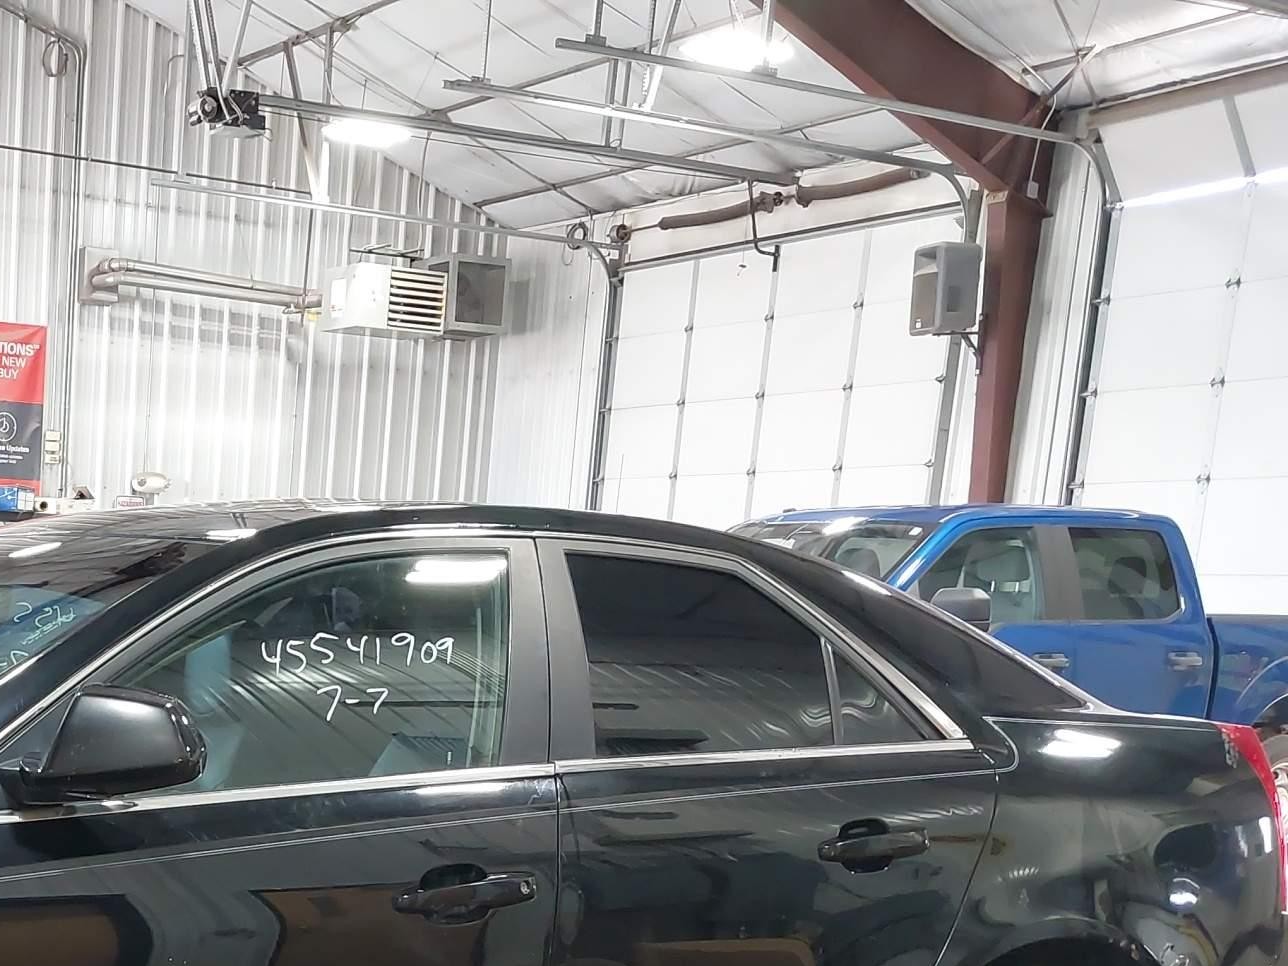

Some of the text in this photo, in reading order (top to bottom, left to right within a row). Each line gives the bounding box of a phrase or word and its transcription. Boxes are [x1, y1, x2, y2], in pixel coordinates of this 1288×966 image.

[5, 356, 26, 368] NEW
[261, 632, 455, 677] 45541909
[316, 685, 389, 722] 7-7
